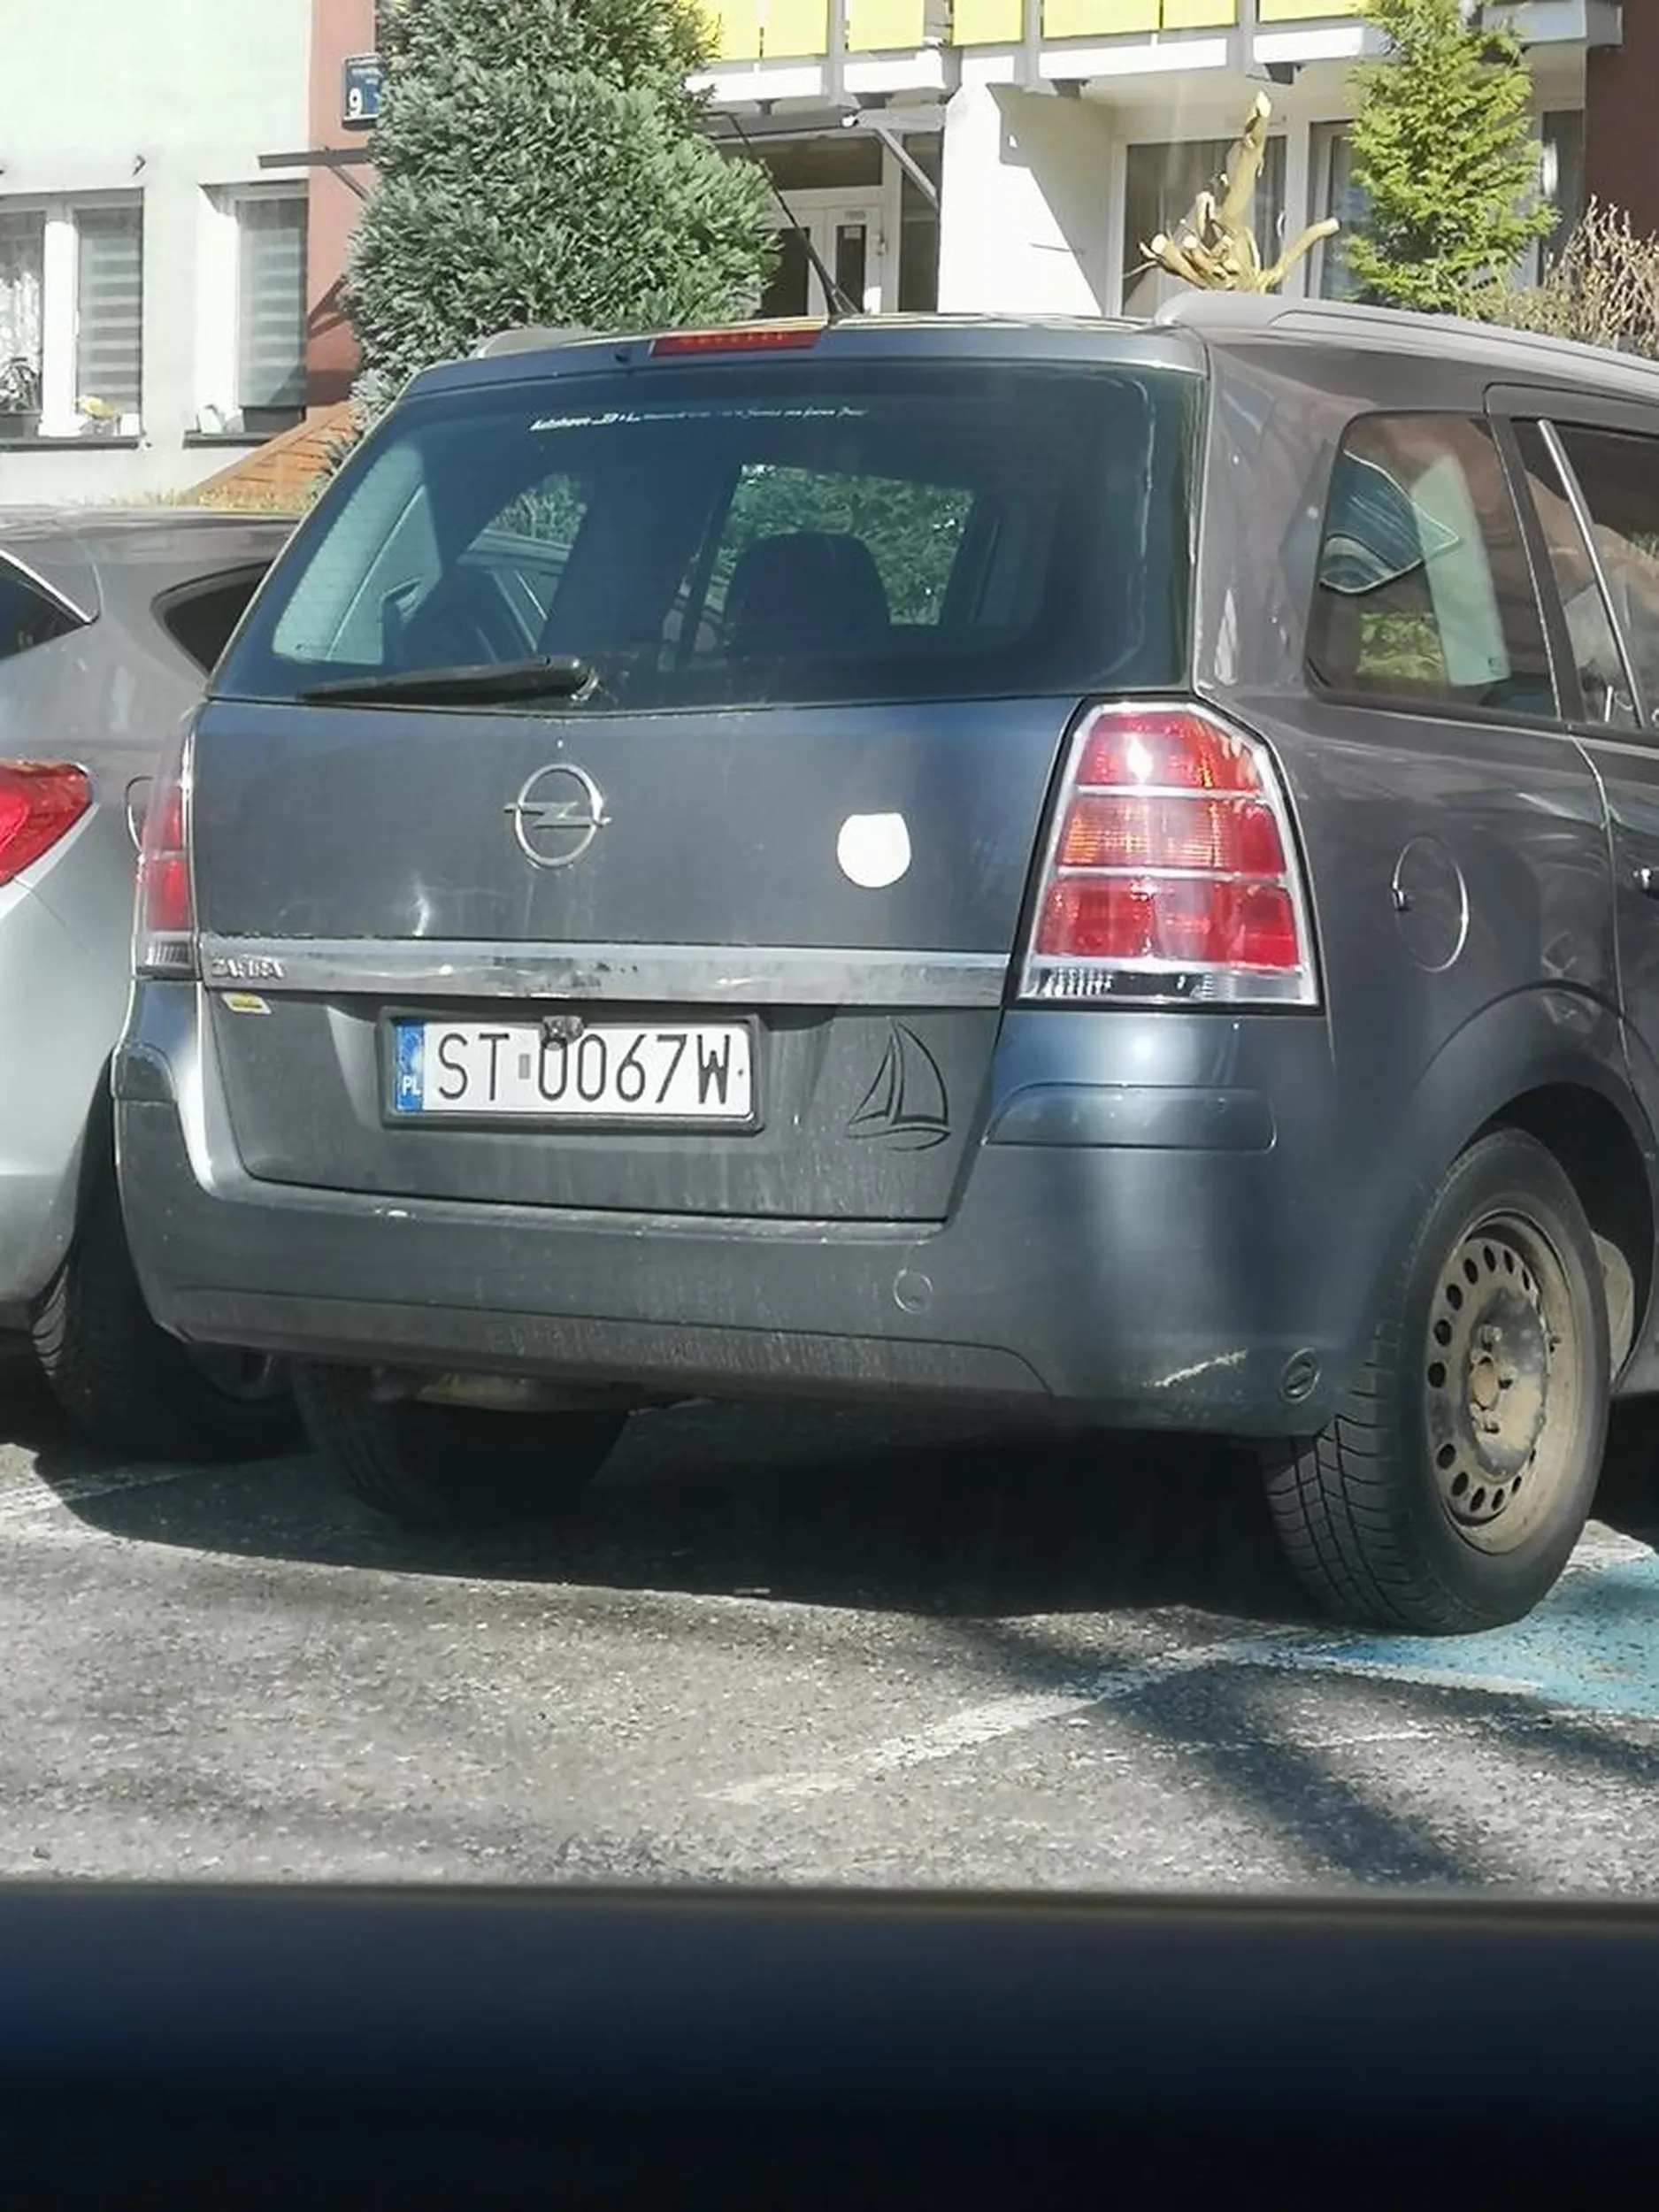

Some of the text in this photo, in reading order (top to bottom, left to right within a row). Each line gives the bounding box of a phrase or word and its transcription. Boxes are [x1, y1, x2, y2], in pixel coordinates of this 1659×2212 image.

[349, 88, 363, 118] 9
[438, 1033, 731, 1104] ST 0067W
[403, 1075, 421, 1095] PL
